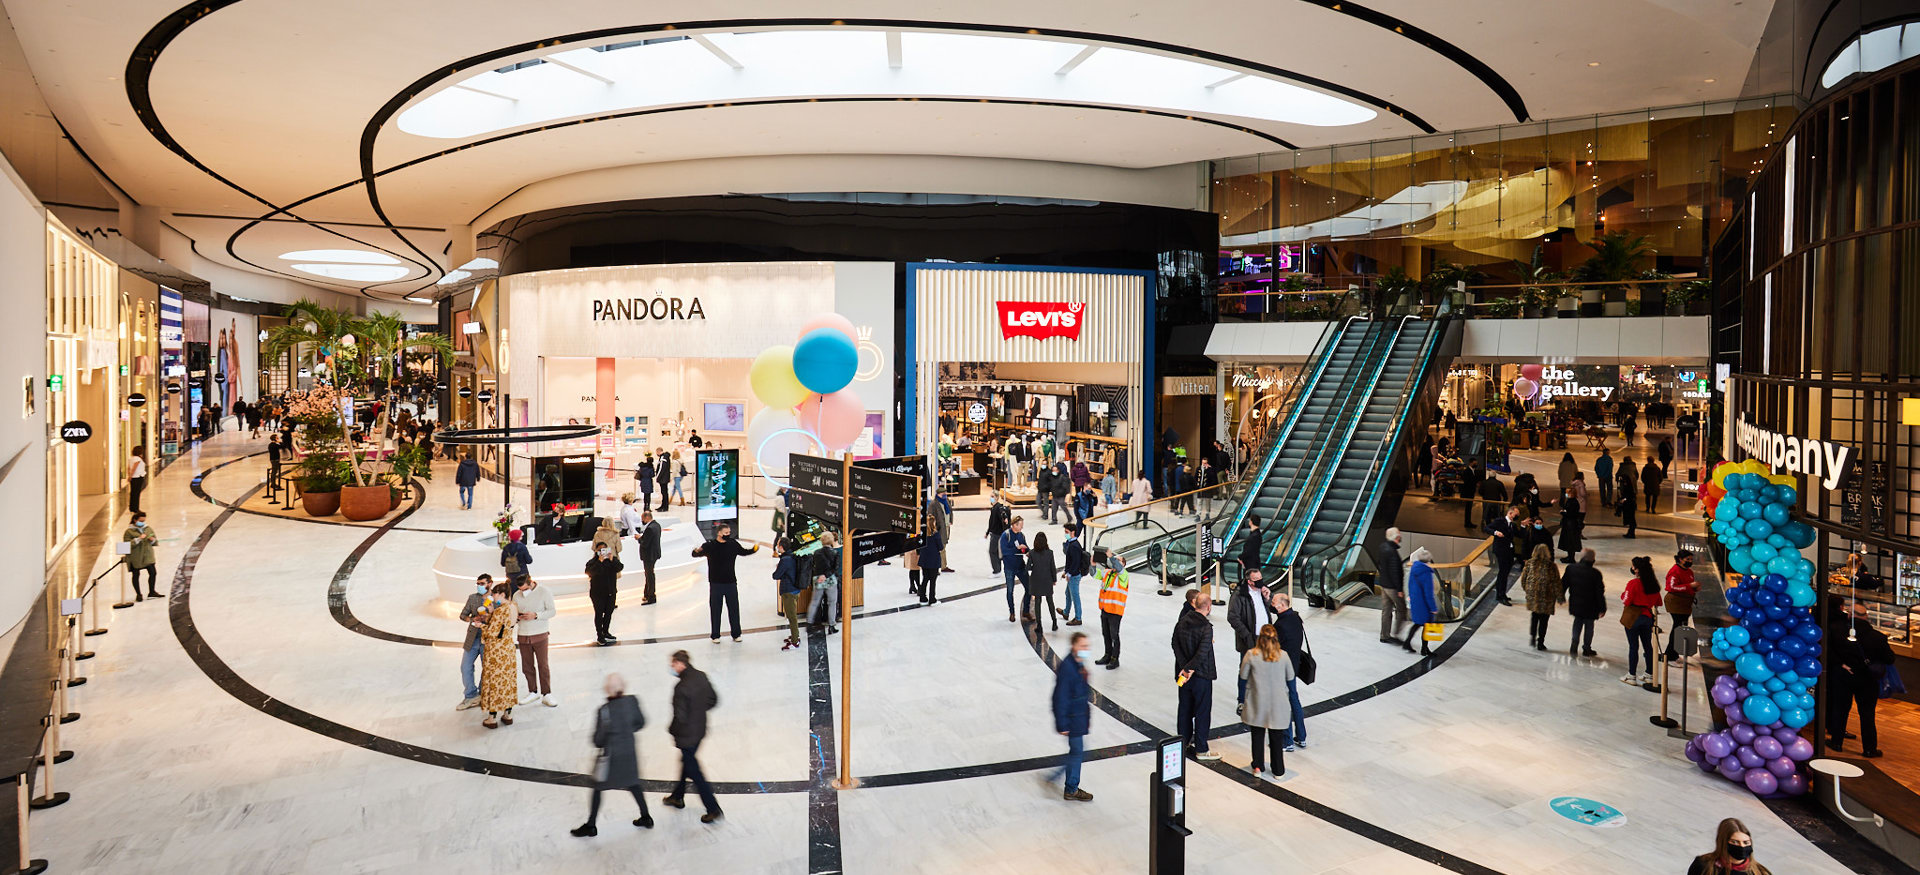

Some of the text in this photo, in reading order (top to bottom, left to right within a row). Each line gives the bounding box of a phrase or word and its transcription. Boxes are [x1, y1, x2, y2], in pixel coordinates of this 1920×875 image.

[593, 297, 706, 321] PANDORA
[1541, 366, 1575, 380] the
[1180, 382, 1210, 394] liften
[1541, 381, 1615, 402] gallery
[63, 427, 89, 438] ZARA
